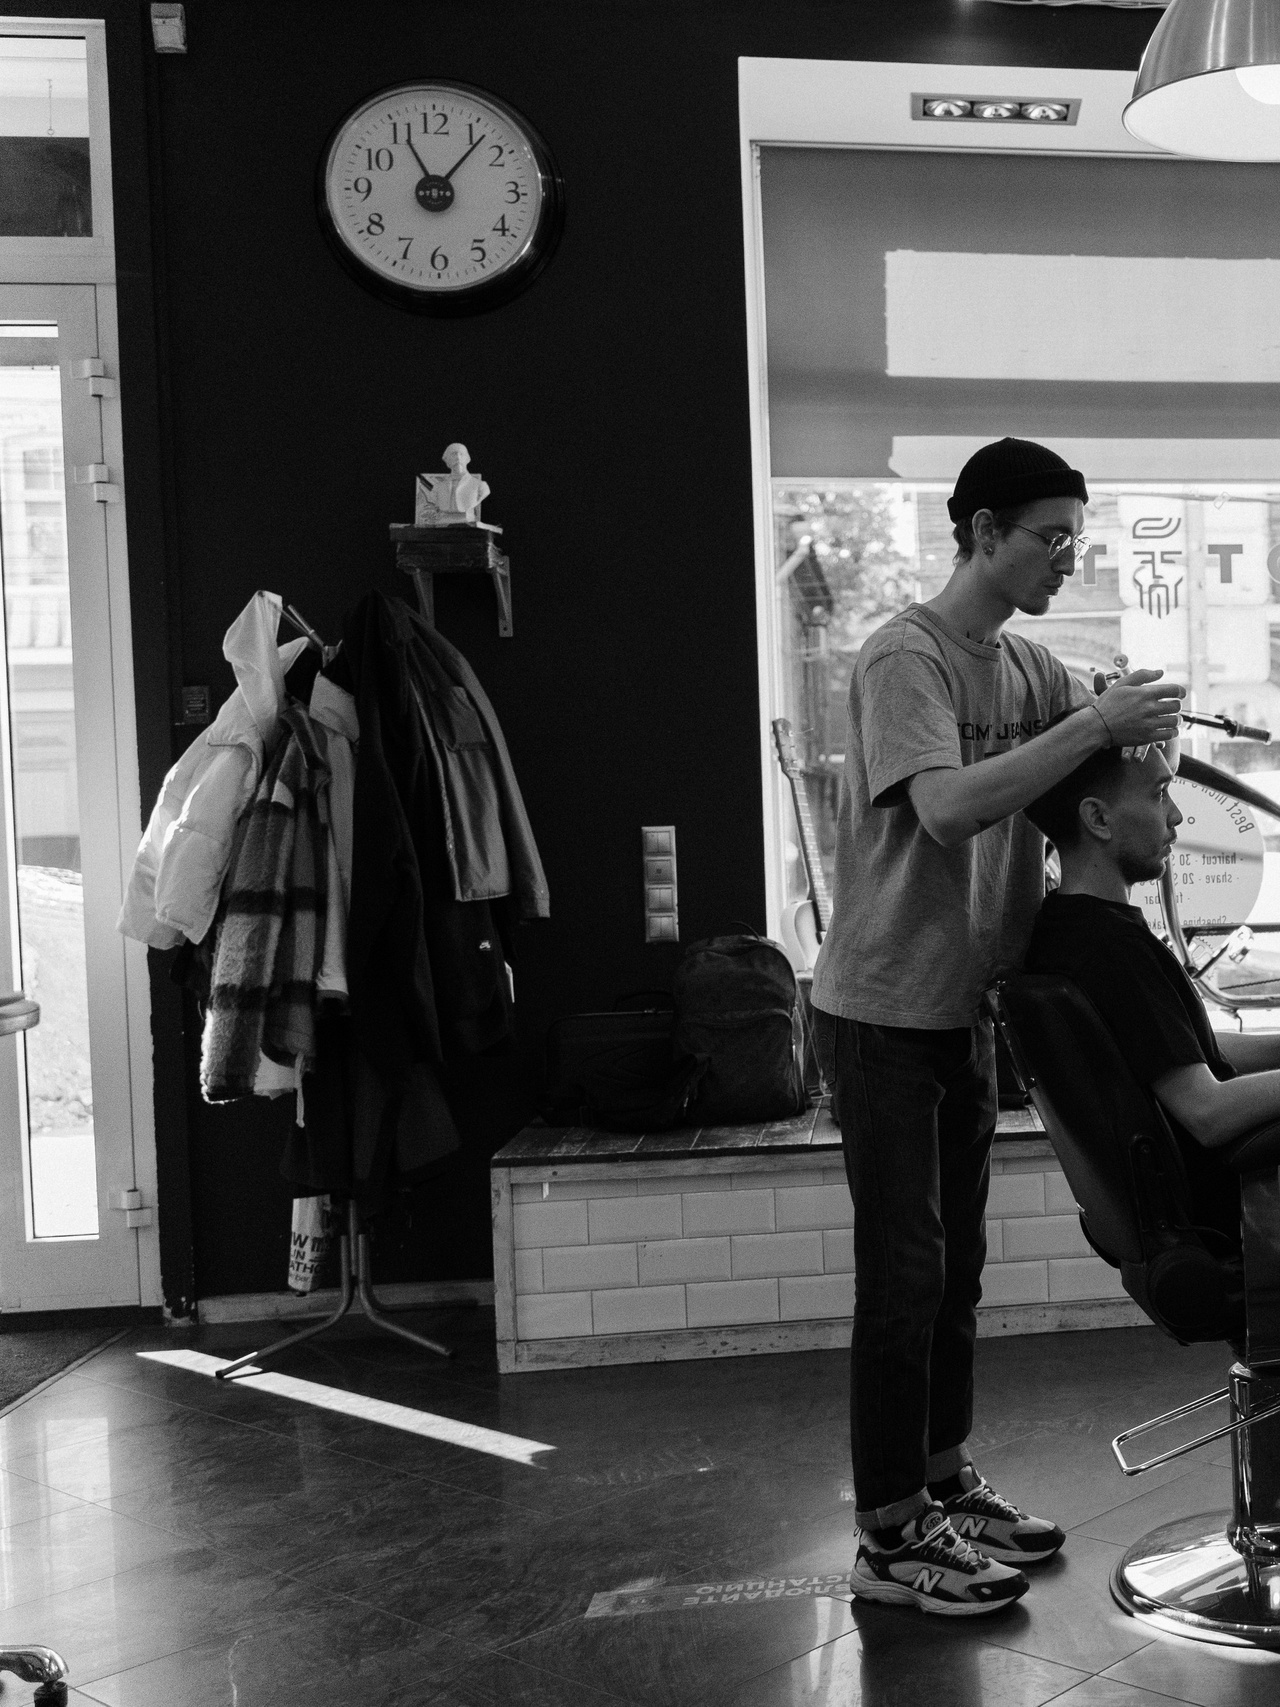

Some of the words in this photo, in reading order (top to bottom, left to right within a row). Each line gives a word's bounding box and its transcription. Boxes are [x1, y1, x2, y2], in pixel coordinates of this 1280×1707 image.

[390, 122, 414, 145] 11
[420, 112, 450, 135] 12
[465, 123, 475, 146] 1
[365, 148, 394, 172] 10
[488, 145, 506, 167] 2
[353, 177, 373, 203] 9
[504, 181, 521, 204] 3
[366, 212, 385, 236] 8
[492, 213, 510, 237] 4
[398, 237, 414, 260] 7
[430, 246, 449, 271] 6
[470, 238, 487, 263] 5
[957, 722, 993, 741] OM
[694, 1573, 852, 1595] СТАНЦИЮ
[911, 1567, 945, 1593] N
[681, 1583, 851, 1607] БЛЮДАЙТЕ
